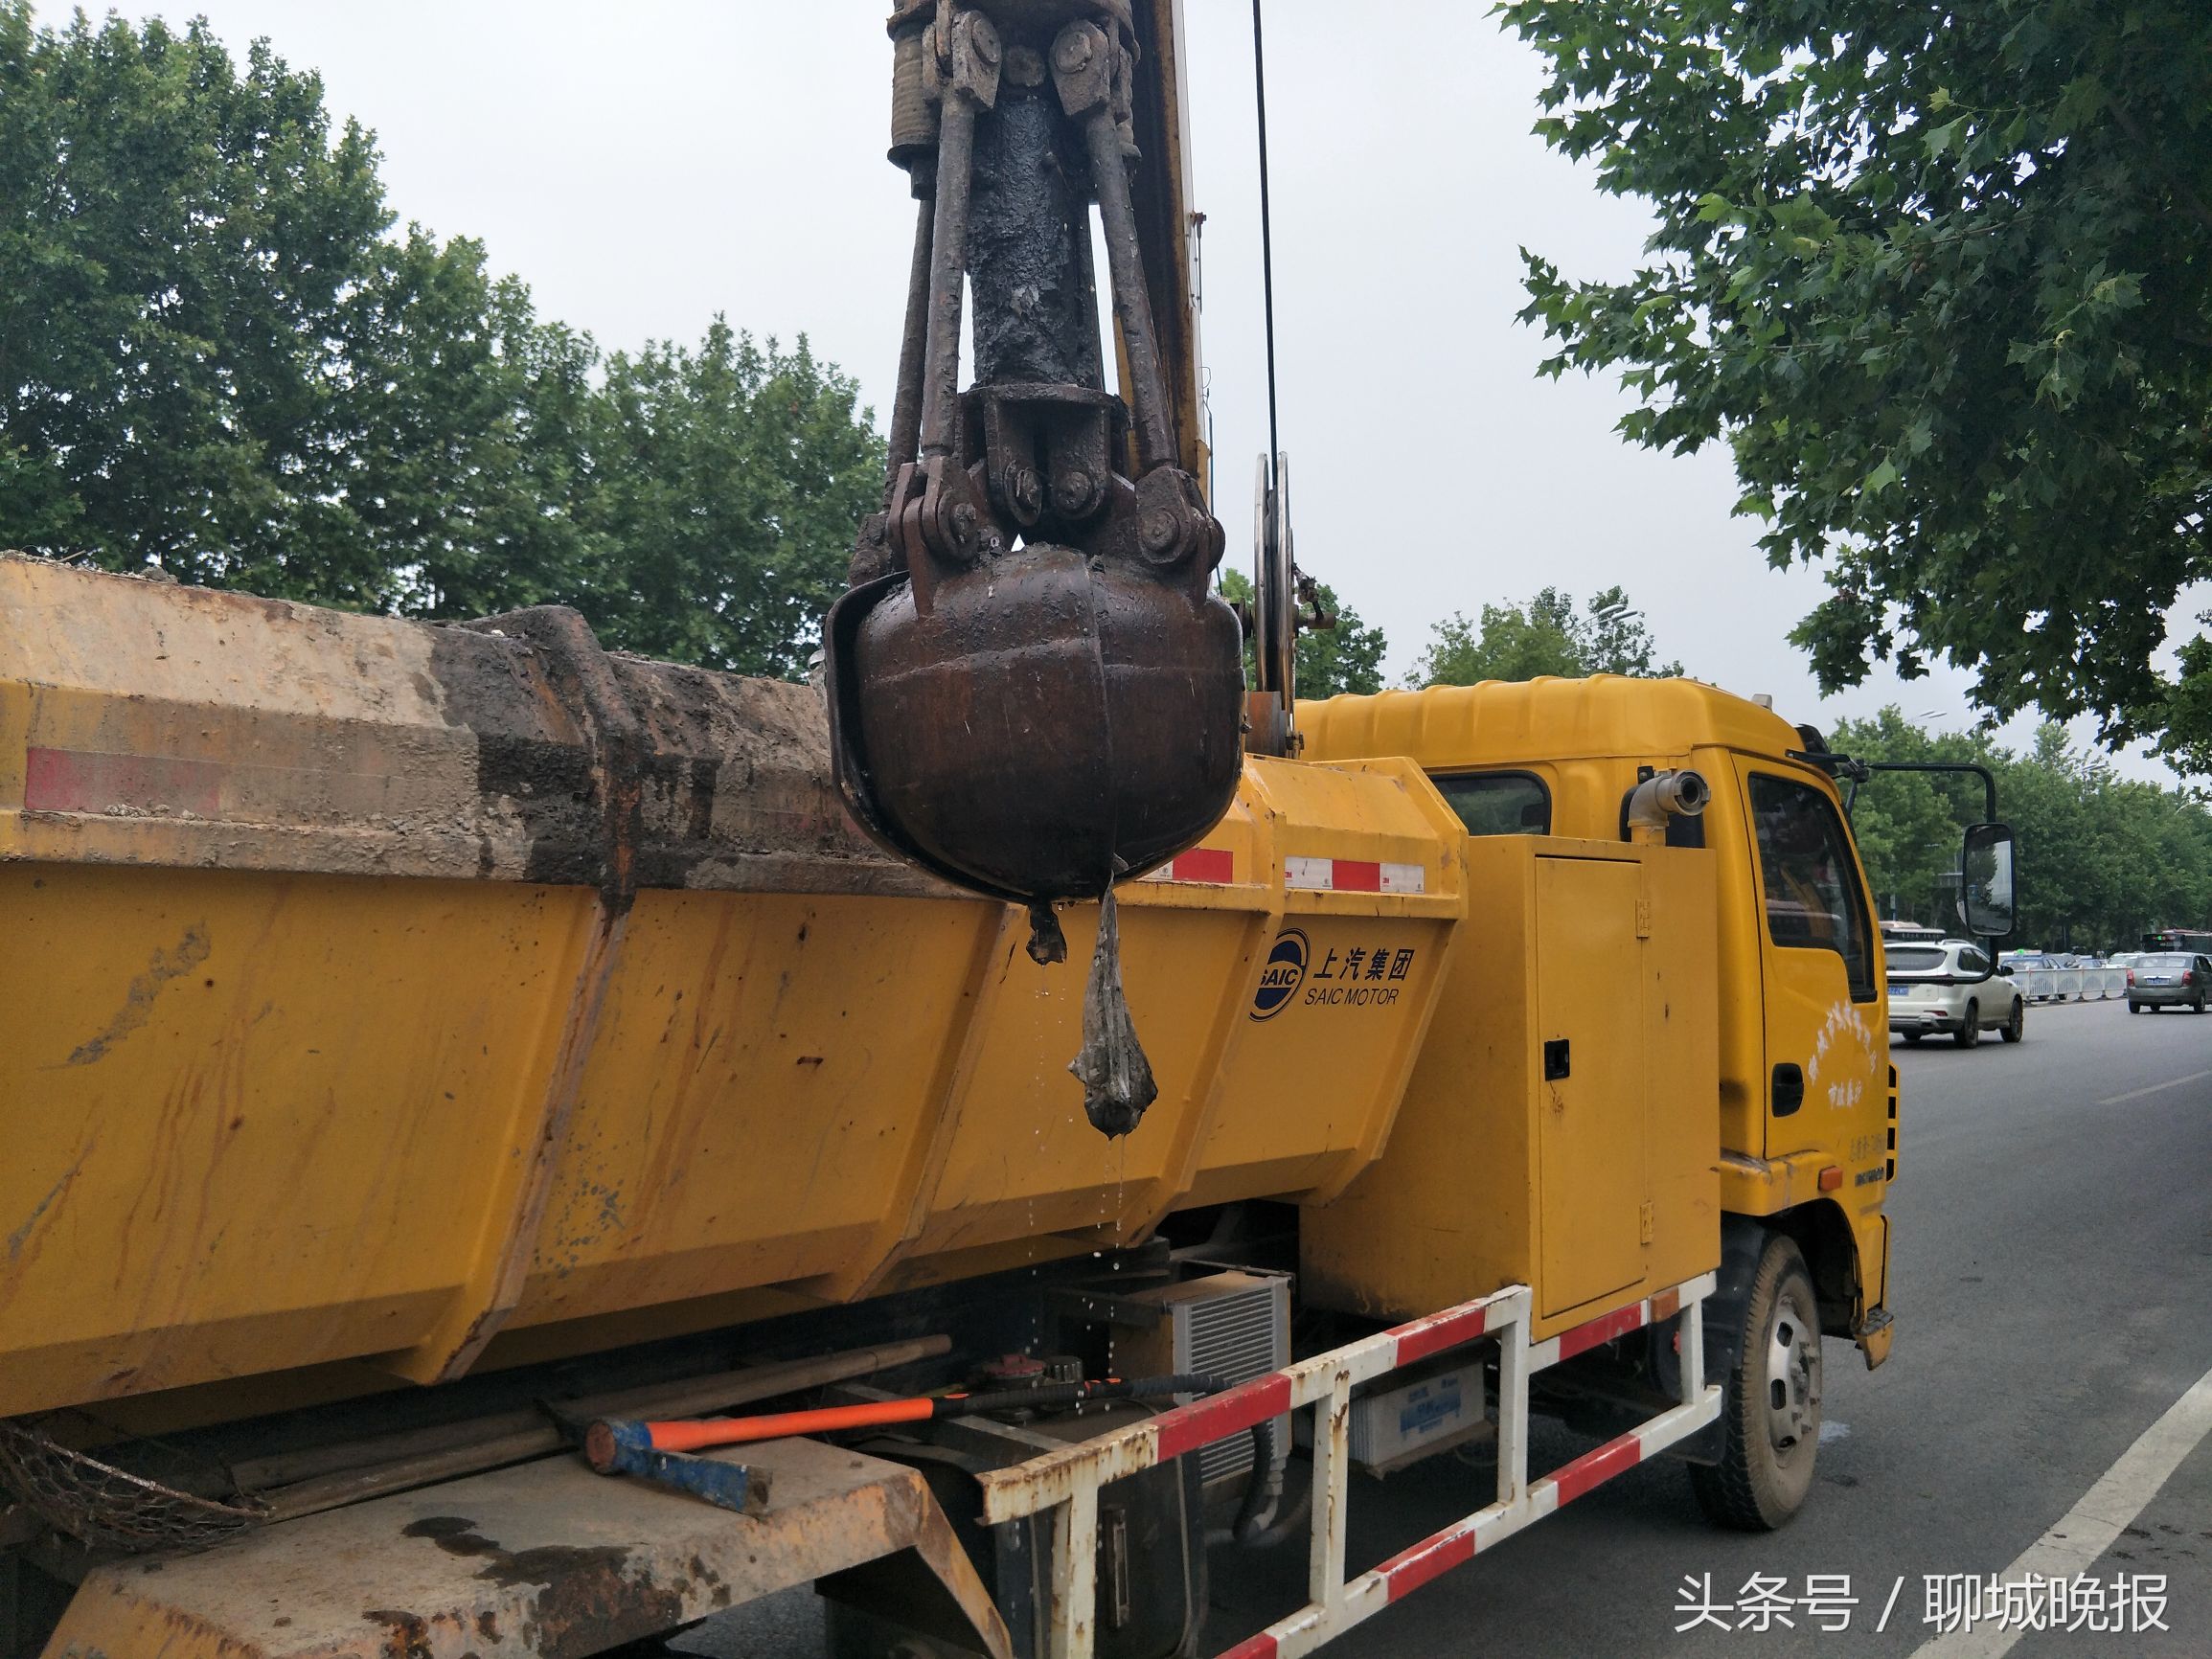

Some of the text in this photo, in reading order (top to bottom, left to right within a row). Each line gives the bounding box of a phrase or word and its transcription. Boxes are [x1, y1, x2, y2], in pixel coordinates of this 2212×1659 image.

[1312, 946, 1415, 981] 上汽集团
[1304, 988, 1400, 1006] SAIC MOTOR
